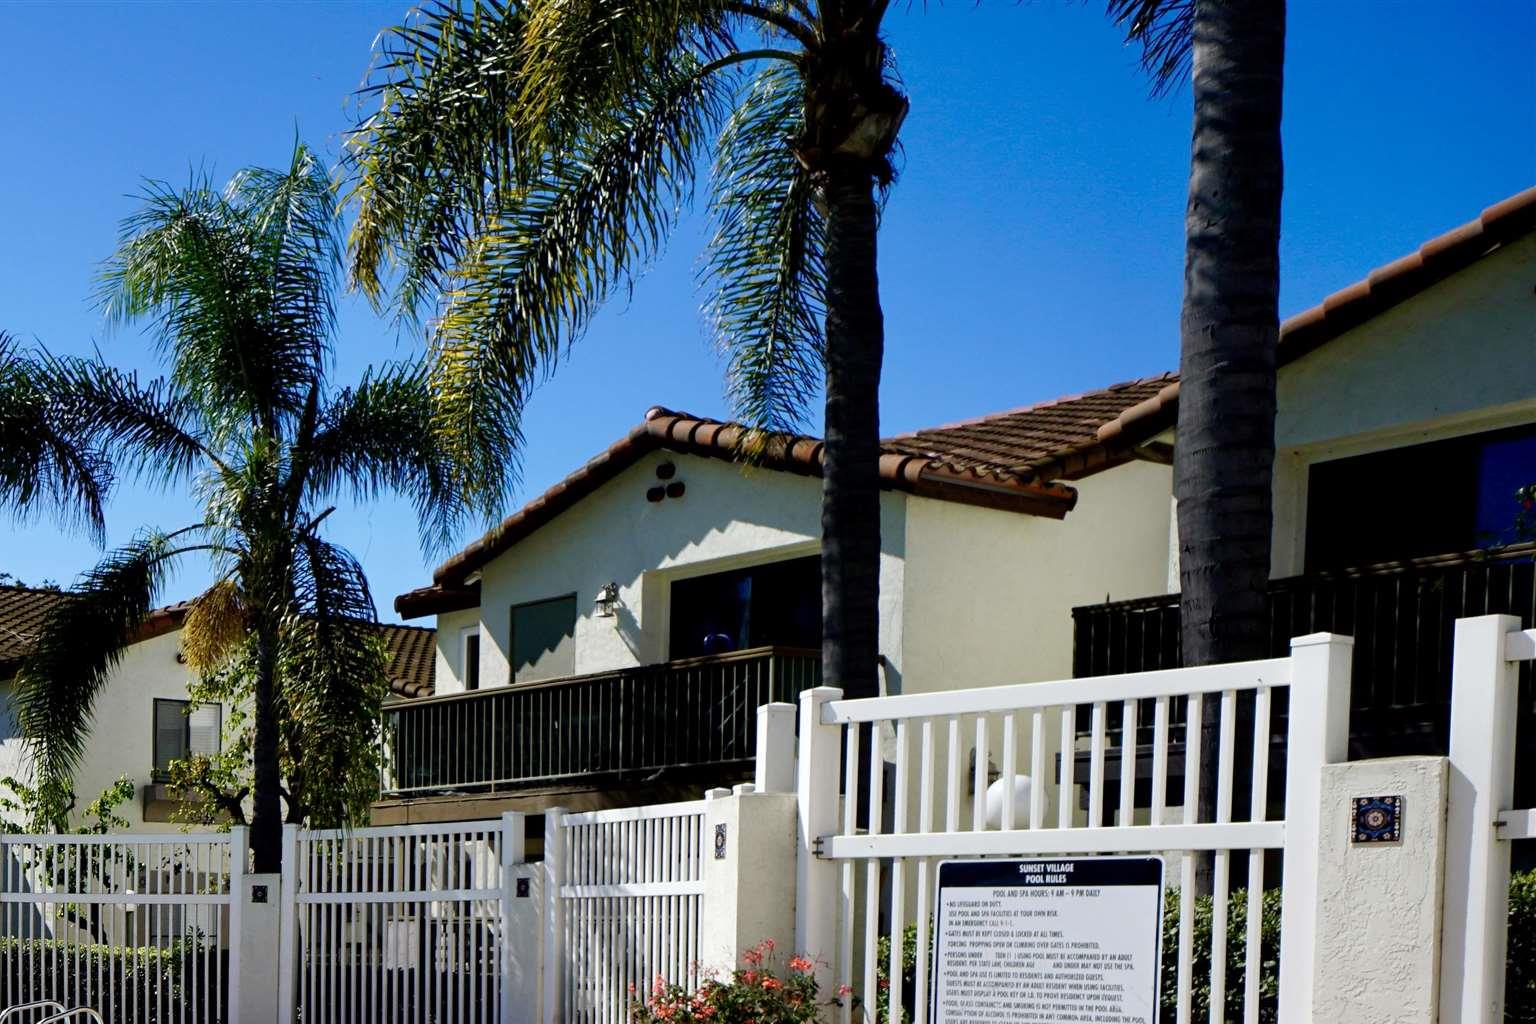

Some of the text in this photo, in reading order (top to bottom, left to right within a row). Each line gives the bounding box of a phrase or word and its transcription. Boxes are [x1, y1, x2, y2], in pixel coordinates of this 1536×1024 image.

[1019, 863, 1073, 872] SUNSET VILLAGE
[1025, 874, 1066, 883] POOL RULES
